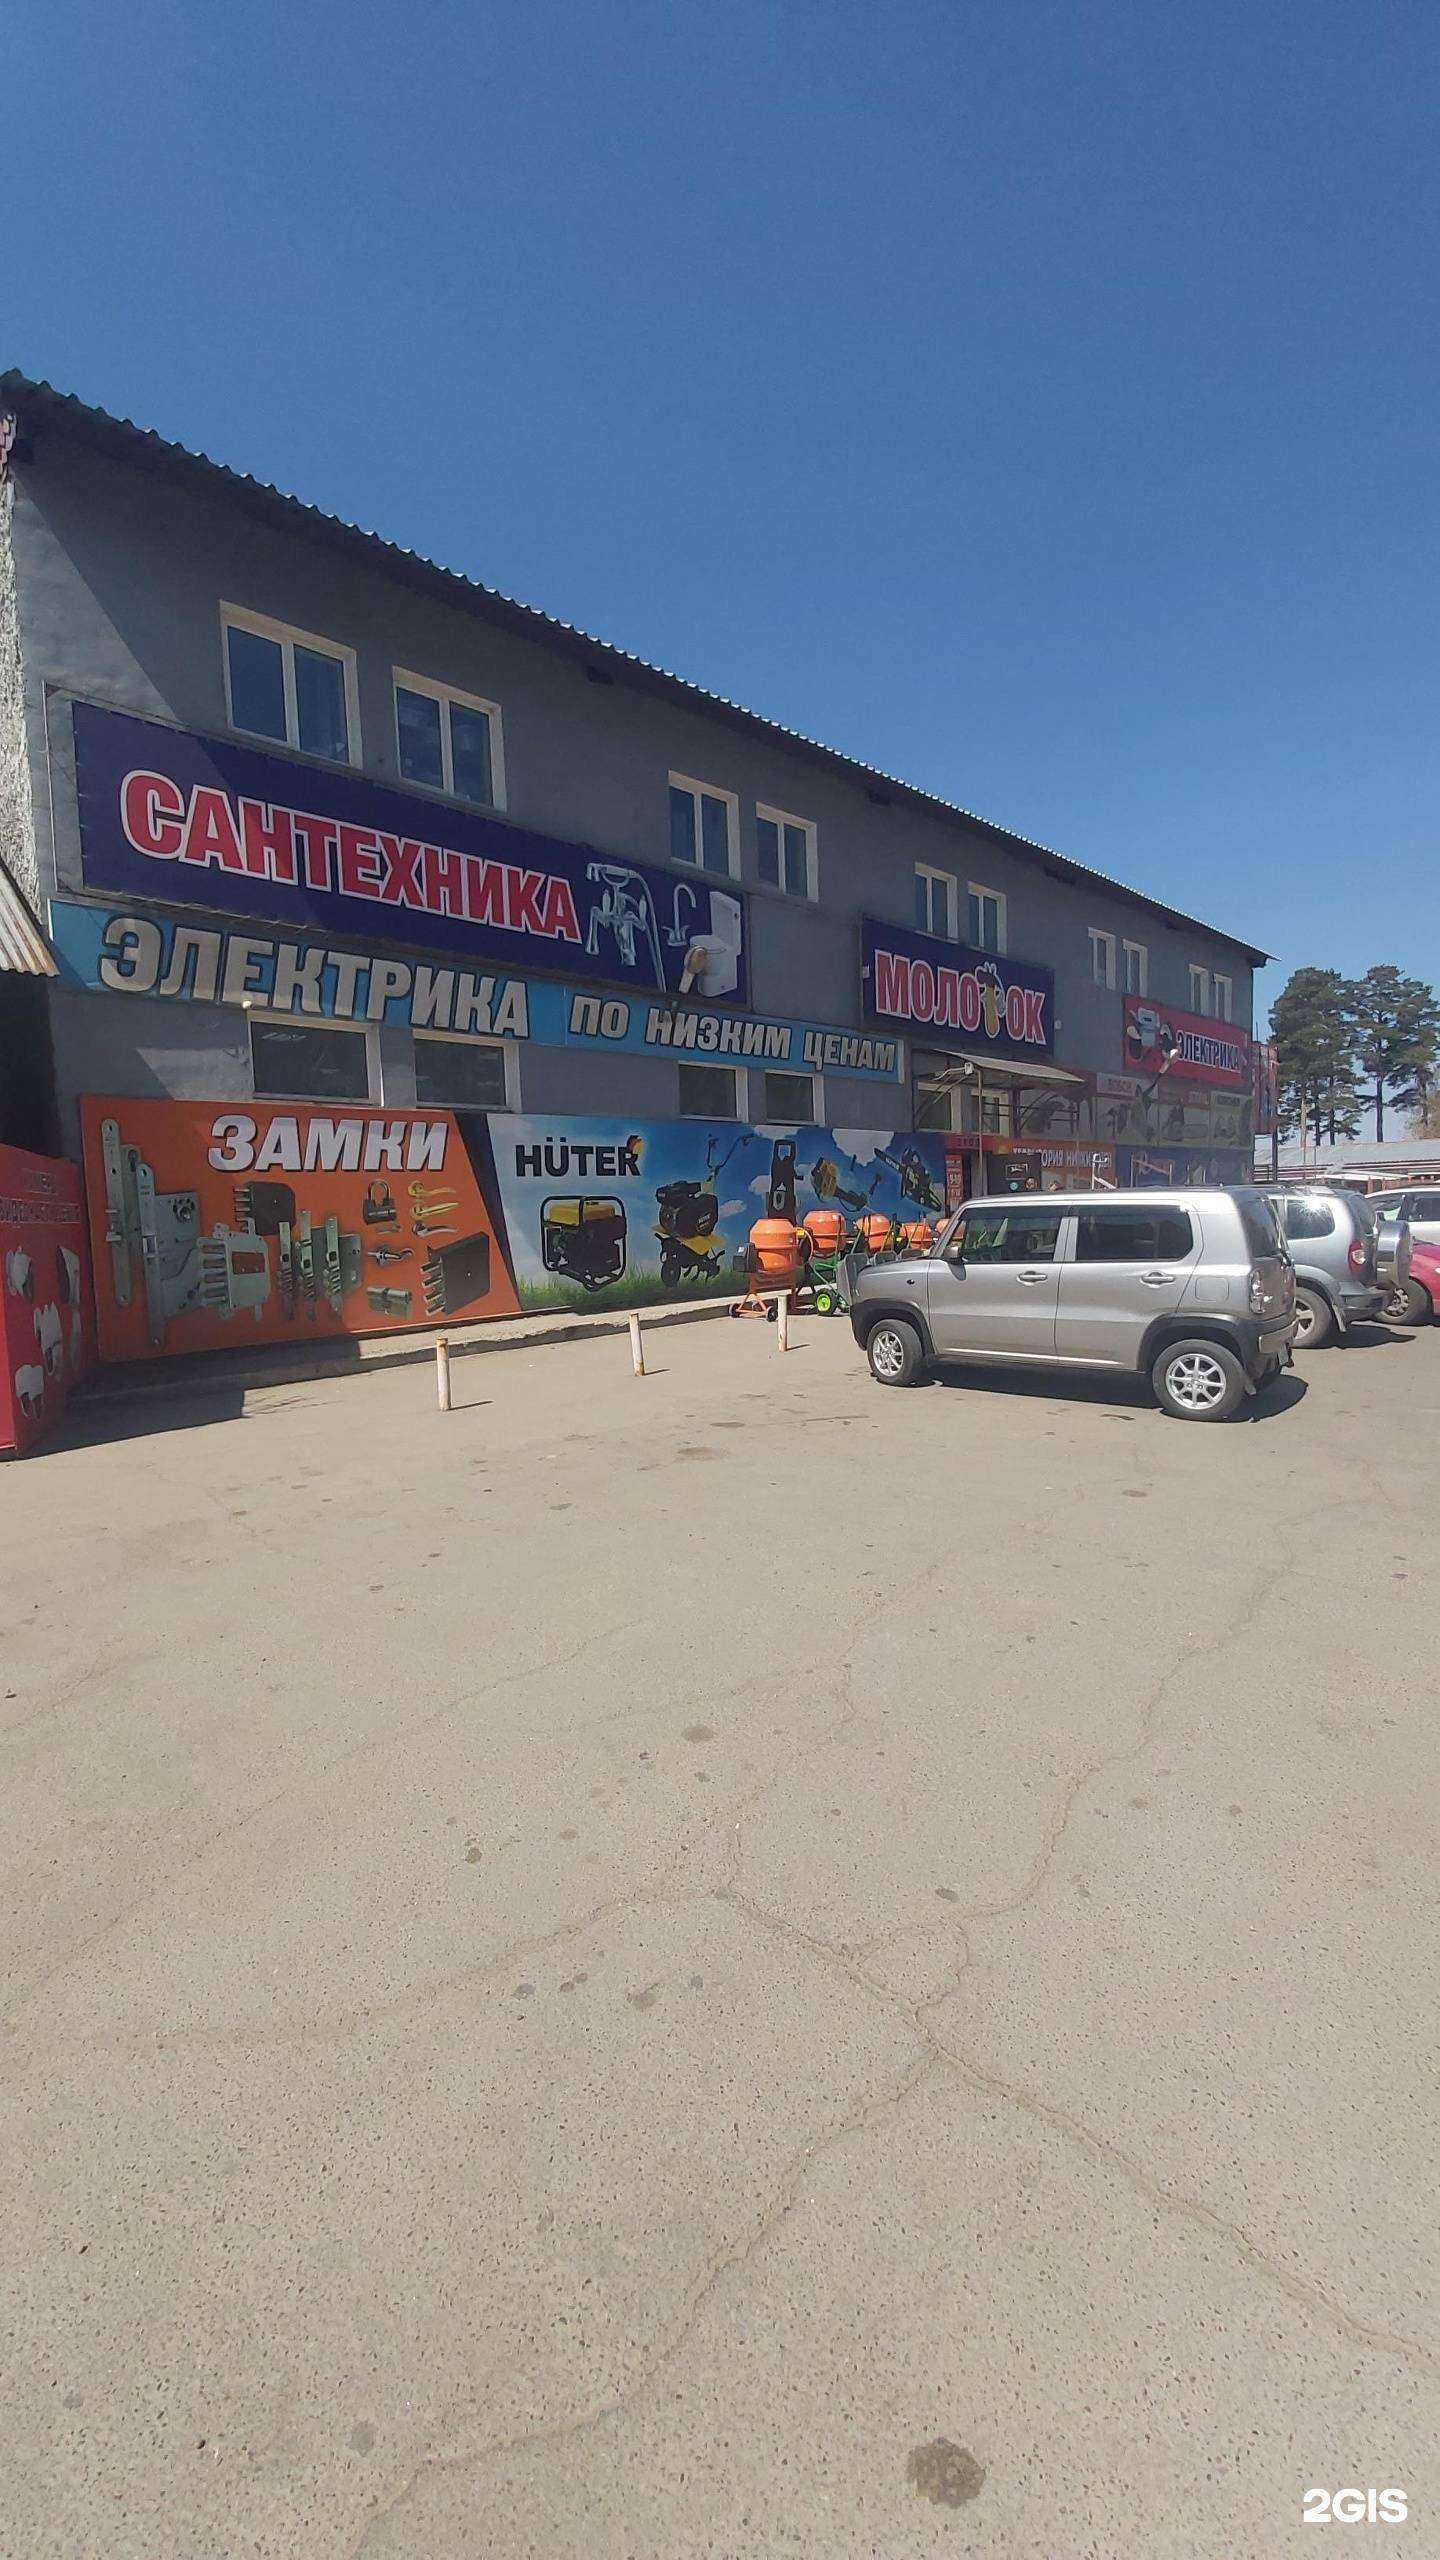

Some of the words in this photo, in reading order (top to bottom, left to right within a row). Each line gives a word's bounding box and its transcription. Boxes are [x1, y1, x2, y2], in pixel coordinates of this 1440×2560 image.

[120, 769, 582, 944] САНТЕХНИКА
[99, 914, 530, 1040] ЭЛЕКТРИКА
[569, 994, 630, 1040] ПО
[645, 1008, 793, 1060] НИЗКИМ
[803, 1031, 898, 1071] ЦЕНАМ
[1175, 1029, 1241, 1074] ЭЛЕКТРИКА
[206, 1113, 450, 1174] ЗАМКИ
[515, 1136, 642, 1178] HÜTER
